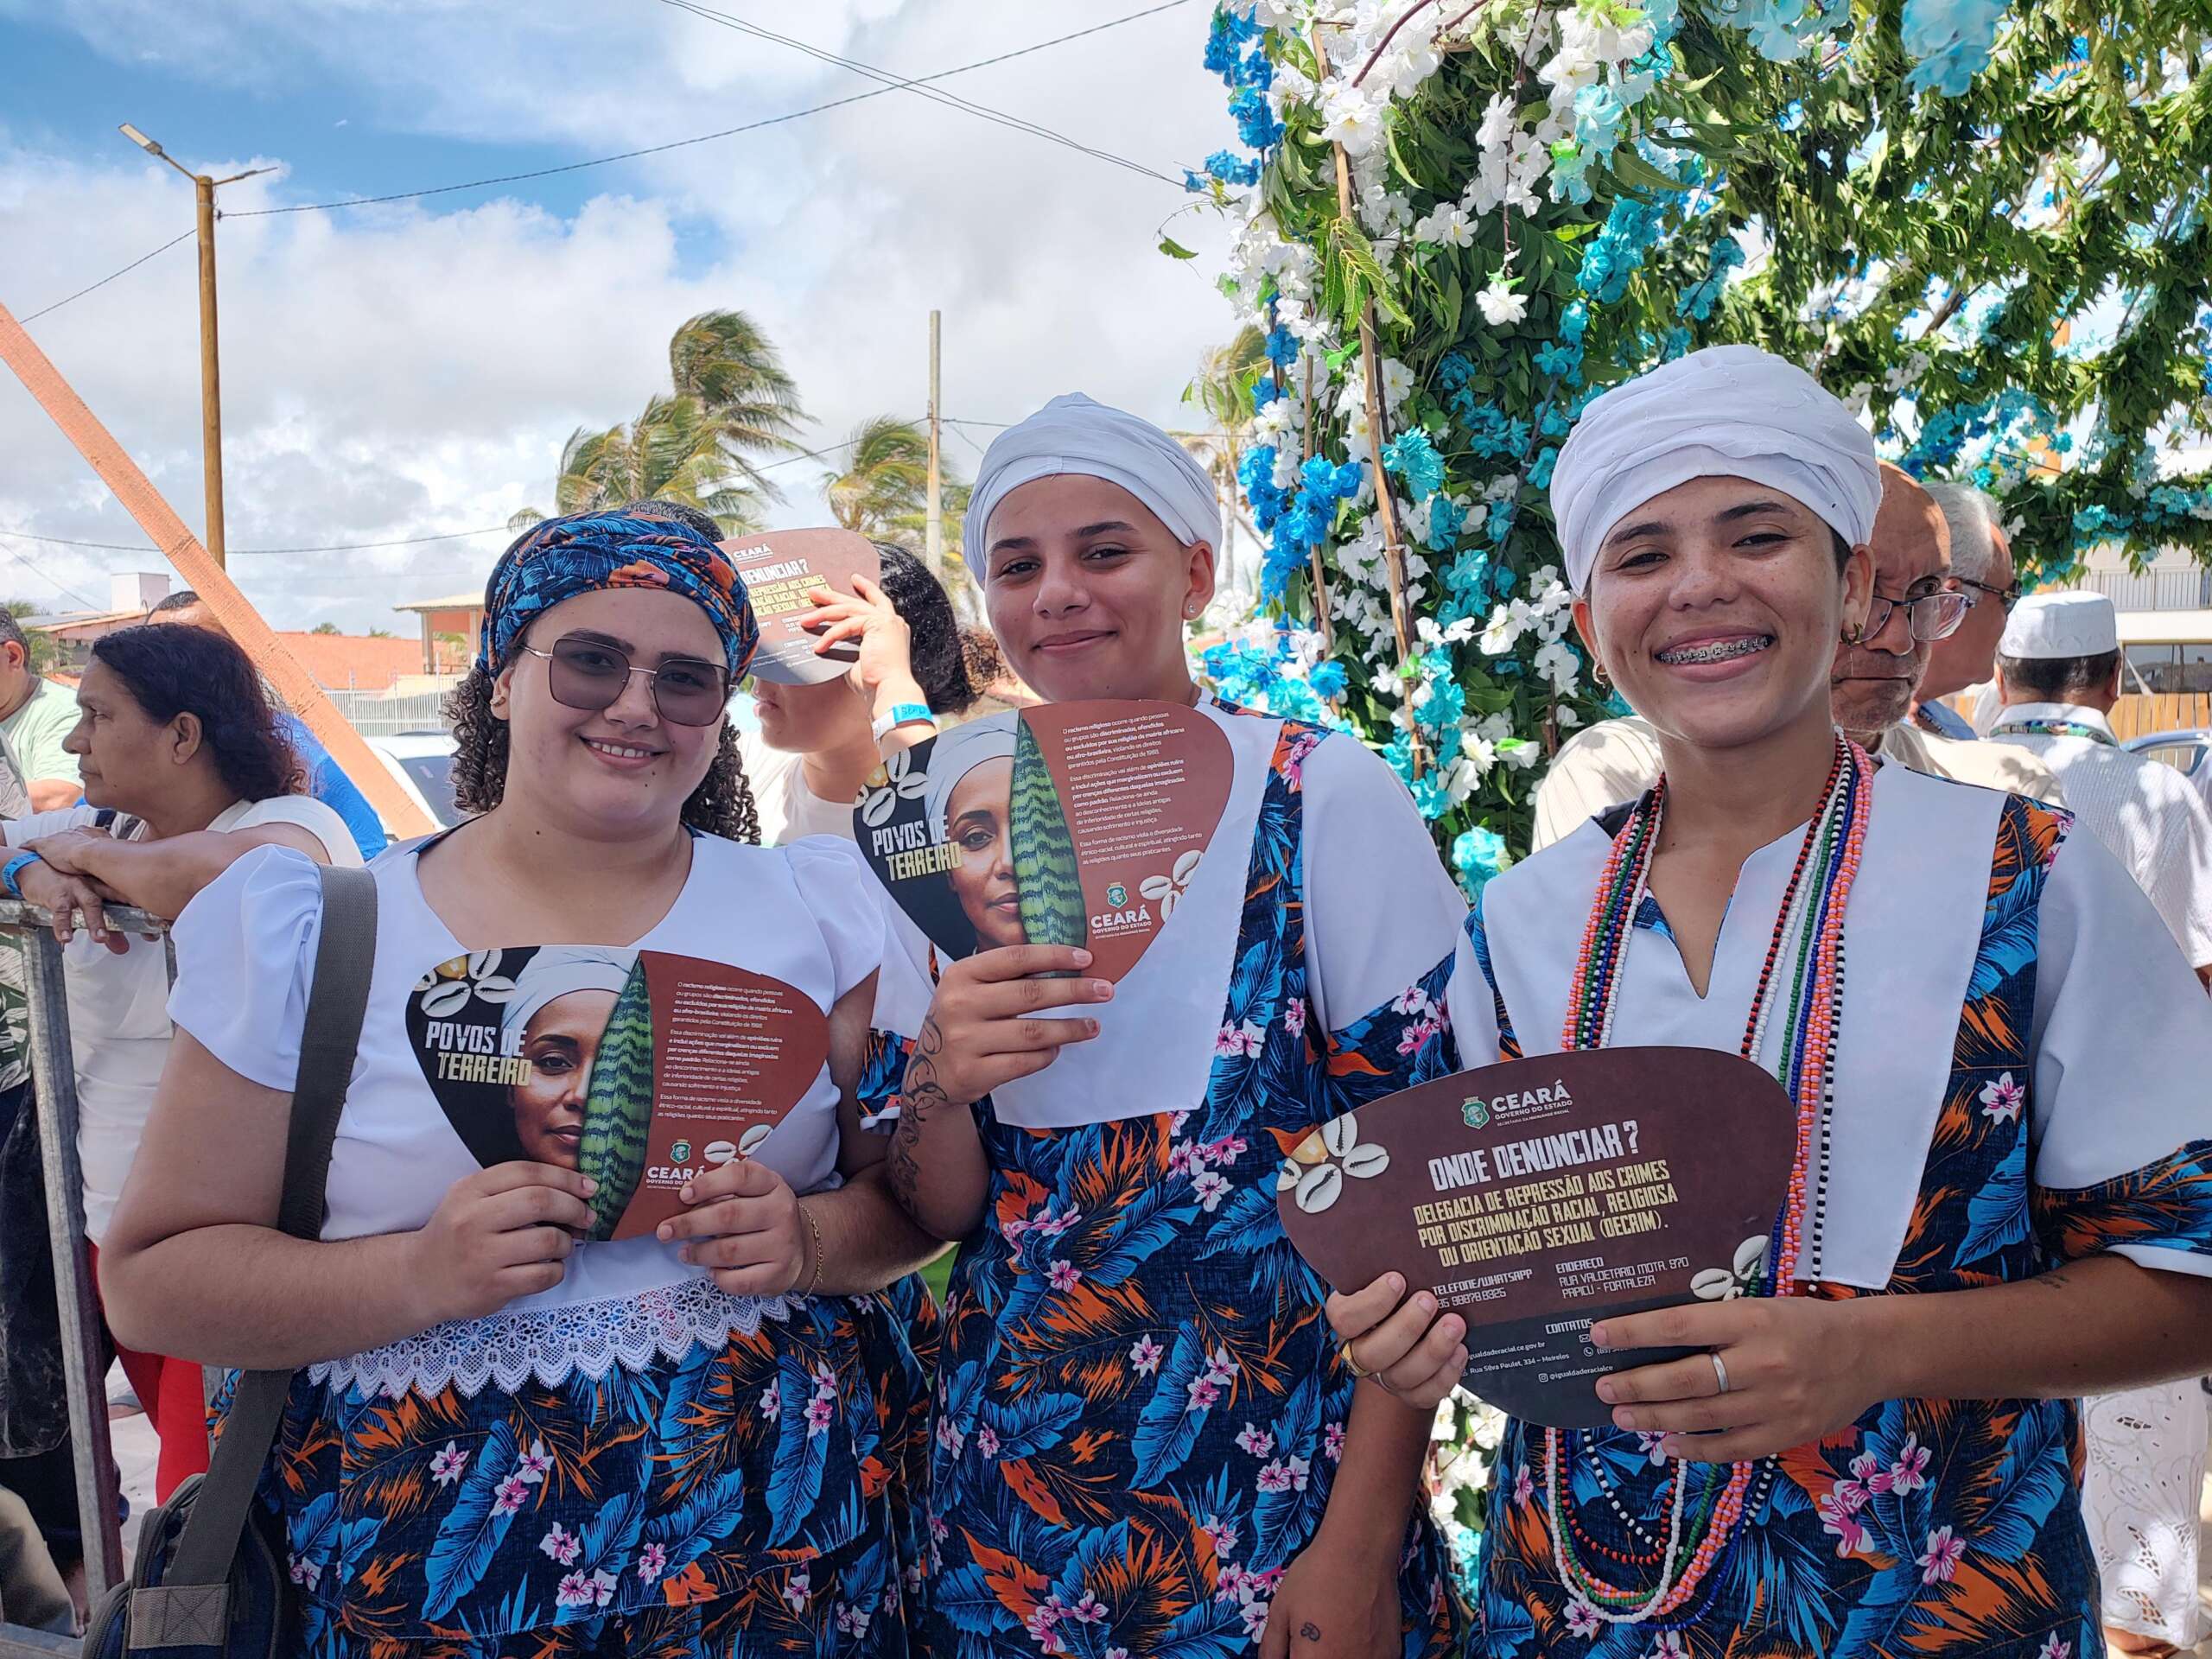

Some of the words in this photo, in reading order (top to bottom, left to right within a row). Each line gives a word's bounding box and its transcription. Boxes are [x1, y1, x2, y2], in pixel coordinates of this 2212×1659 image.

[872, 820, 926, 856] POVOS
[929, 815, 950, 844] DE
[885, 842, 963, 881] TERREIRO
[1090, 904, 1151, 928] CEARÁ
[425, 1021, 496, 1054] POVOS
[500, 1028, 527, 1057] DE
[437, 1052, 532, 1086] TERREIRO
[1491, 1079, 1571, 1112] CEARÁ
[1495, 1108, 1529, 1120] GOVERNO
[1544, 1100, 1573, 1110] ESTADO
[1427, 1150, 1491, 1192] ONDE
[1413, 1196, 1483, 1225] DELEGACIA
[1485, 1192, 1504, 1210] DE
[1506, 1175, 1584, 1206] REPRESSÃO
[1588, 1170, 1615, 1192] AOS
[1618, 1160, 1670, 1185] CRIMES
[1418, 1225, 1446, 1248] POR
[1449, 1206, 1548, 1243] DISCRIMINAÇÃO
[1553, 1198, 1605, 1222] RACIAL,
[1606, 1183, 1678, 1211] RELIGIOSA
[1439, 1246, 1459, 1268] OU
[1461, 1229, 1541, 1264] ORIENTAÇÃO
[1546, 1222, 1595, 1250] SEXUAL
[1599, 1210, 1669, 1239] (DECRIM).
[1555, 1257, 1604, 1274] ENDEREÇO
[1560, 1275, 1580, 1287] RUA
[1669, 1256, 1689, 1269] 970
[1433, 1269, 1533, 1296] TELEFONE/WHATSAPP
[1562, 1284, 1595, 1299] PAPICU
[1603, 1274, 1656, 1293] FORTALEZA
[1545, 1319, 1593, 1334] CONTATOS
[1484, 1363, 1499, 1372] Silva
